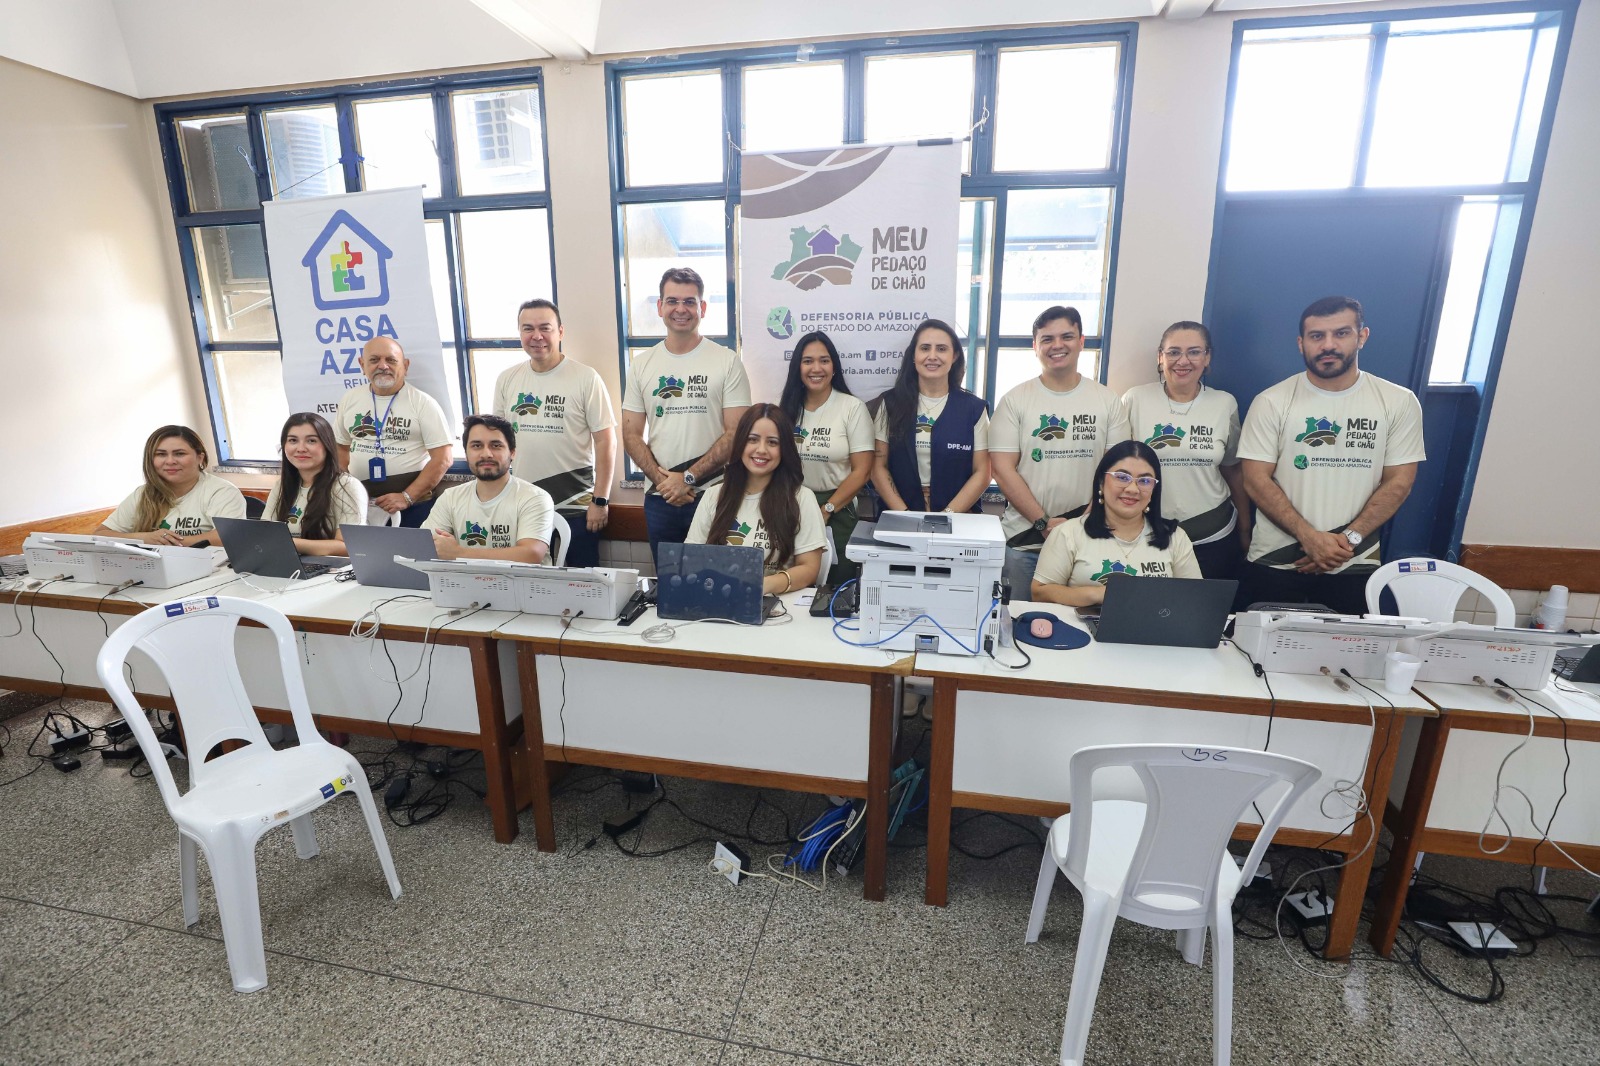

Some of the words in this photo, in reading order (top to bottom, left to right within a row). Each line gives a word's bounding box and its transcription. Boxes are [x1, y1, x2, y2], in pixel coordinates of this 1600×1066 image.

[872, 226, 928, 255] MEU
[871, 255, 927, 274] PEDAÇO
[871, 276, 888, 291] DE
[892, 273, 926, 290] CHÃO
[800, 312, 875, 322] DEFENSORIA
[878, 309, 930, 321] PÚBLICA
[315, 313, 399, 345] CASA
[800, 324, 815, 333] DO
[817, 323, 855, 333] ESTADO
[857, 323, 872, 332] DO
[688, 375, 708, 385] MEU
[545, 394, 566, 405] MEU
[386, 416, 412, 428] MEU
[1072, 414, 1097, 425] MEU
[1347, 417, 1378, 431] MEU
[812, 427, 831, 436] MEU
[1072, 425, 1097, 434] PEDAÇO
[1190, 425, 1213, 436] MEU
[1072, 433, 1080, 441] DE
[1081, 433, 1096, 441] CHÃO
[1346, 431, 1377, 441] PEDAÇO
[947, 443, 972, 451] DPE-AM
[1345, 440, 1356, 449] DE
[1357, 440, 1375, 450] CHÃO
[175, 516, 201, 530] MEU
[491, 525, 510, 535] MEU
[1141, 561, 1166, 574] MEU
